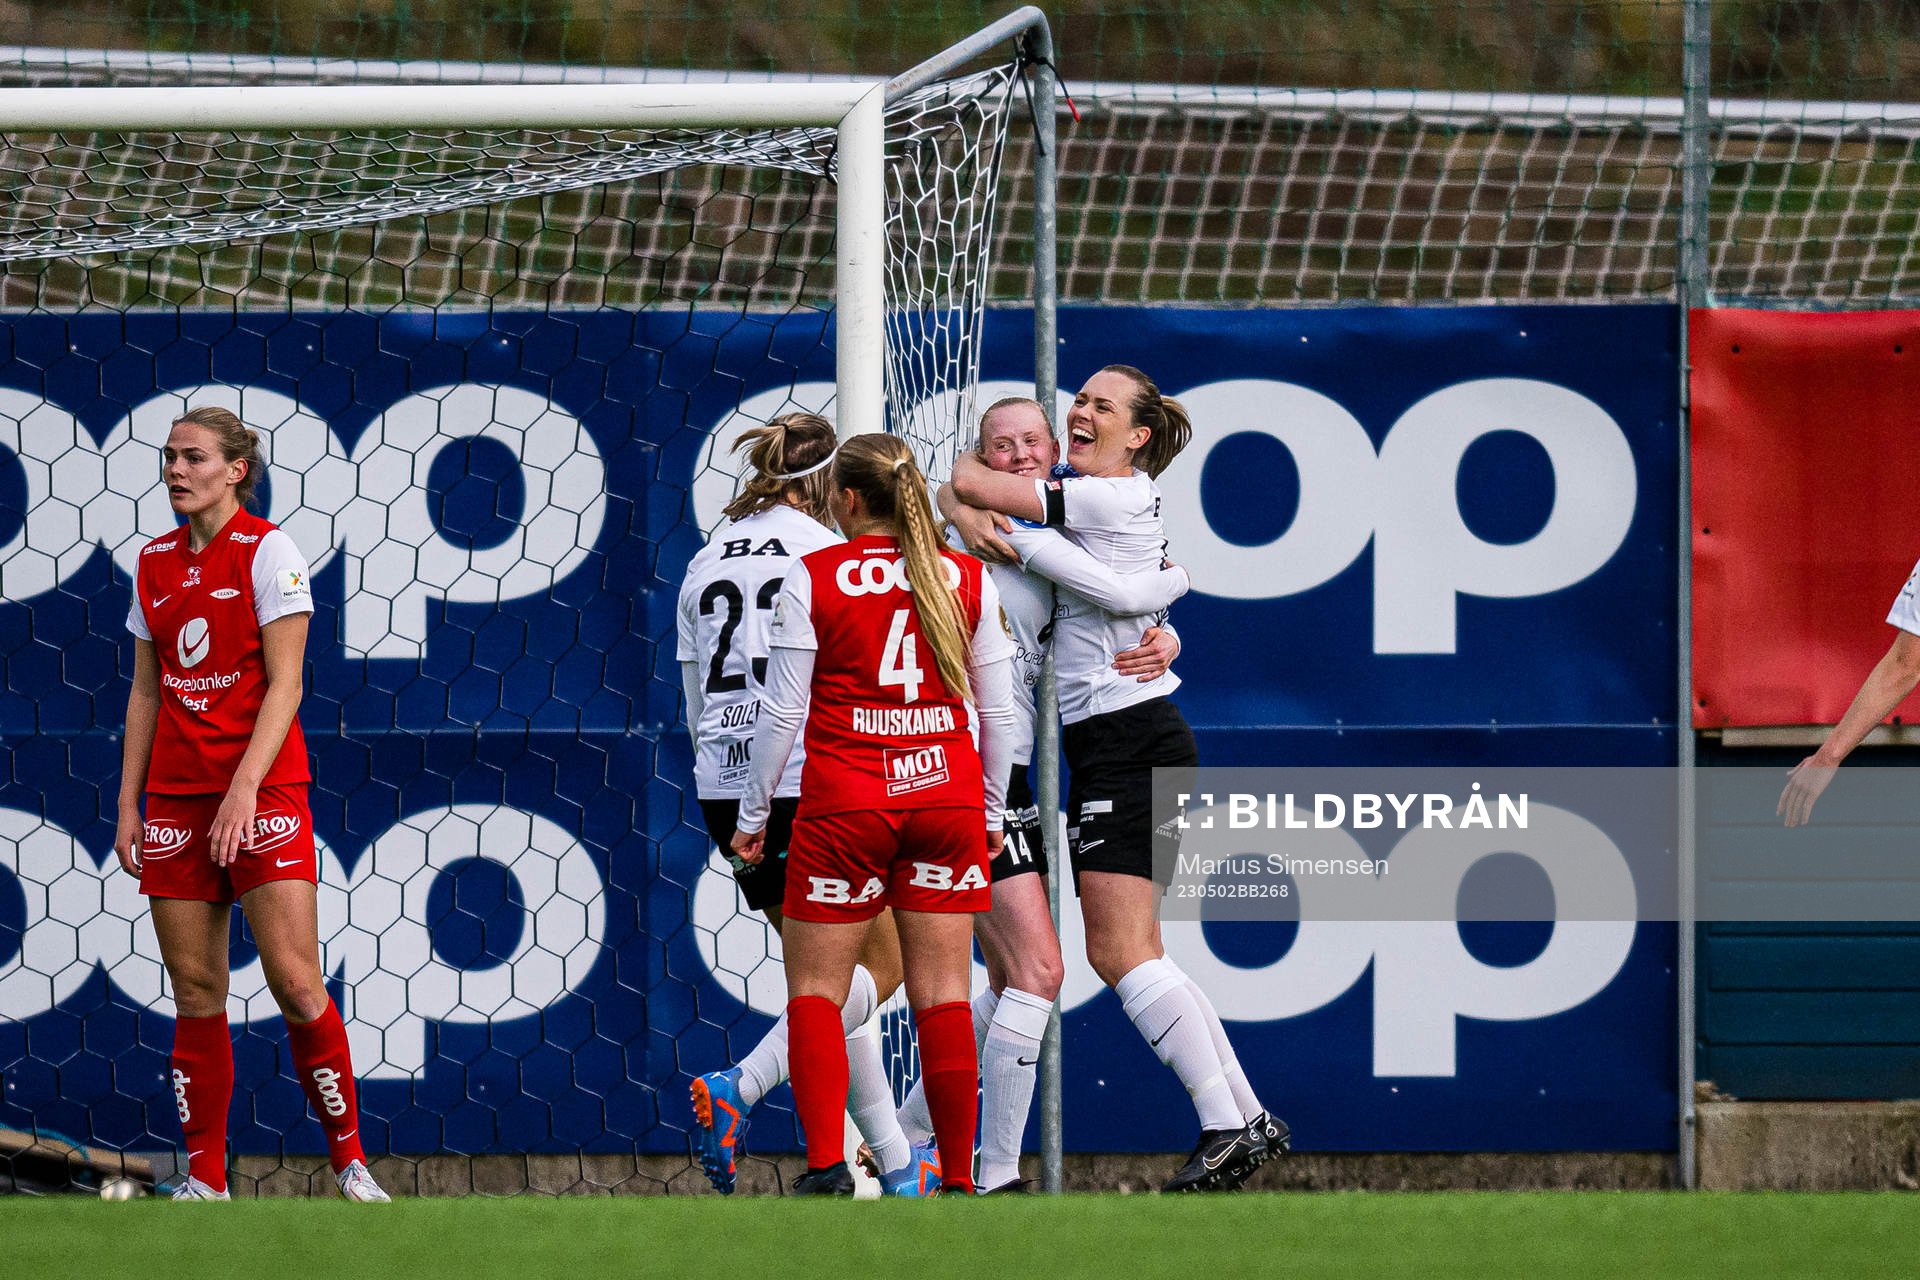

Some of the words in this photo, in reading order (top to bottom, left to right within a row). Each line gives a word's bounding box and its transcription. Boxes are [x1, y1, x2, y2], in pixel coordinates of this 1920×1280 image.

[720, 538, 790, 560] BA
[879, 608, 924, 704] 4
[853, 706, 955, 735] RUUSKANEN
[892, 745, 944, 779] MOT
[143, 822, 188, 845] ERØY
[1003, 831, 1033, 865] 14
[806, 876, 886, 904] BA
[908, 862, 989, 891] BA
[313, 1067, 347, 1117] coop
